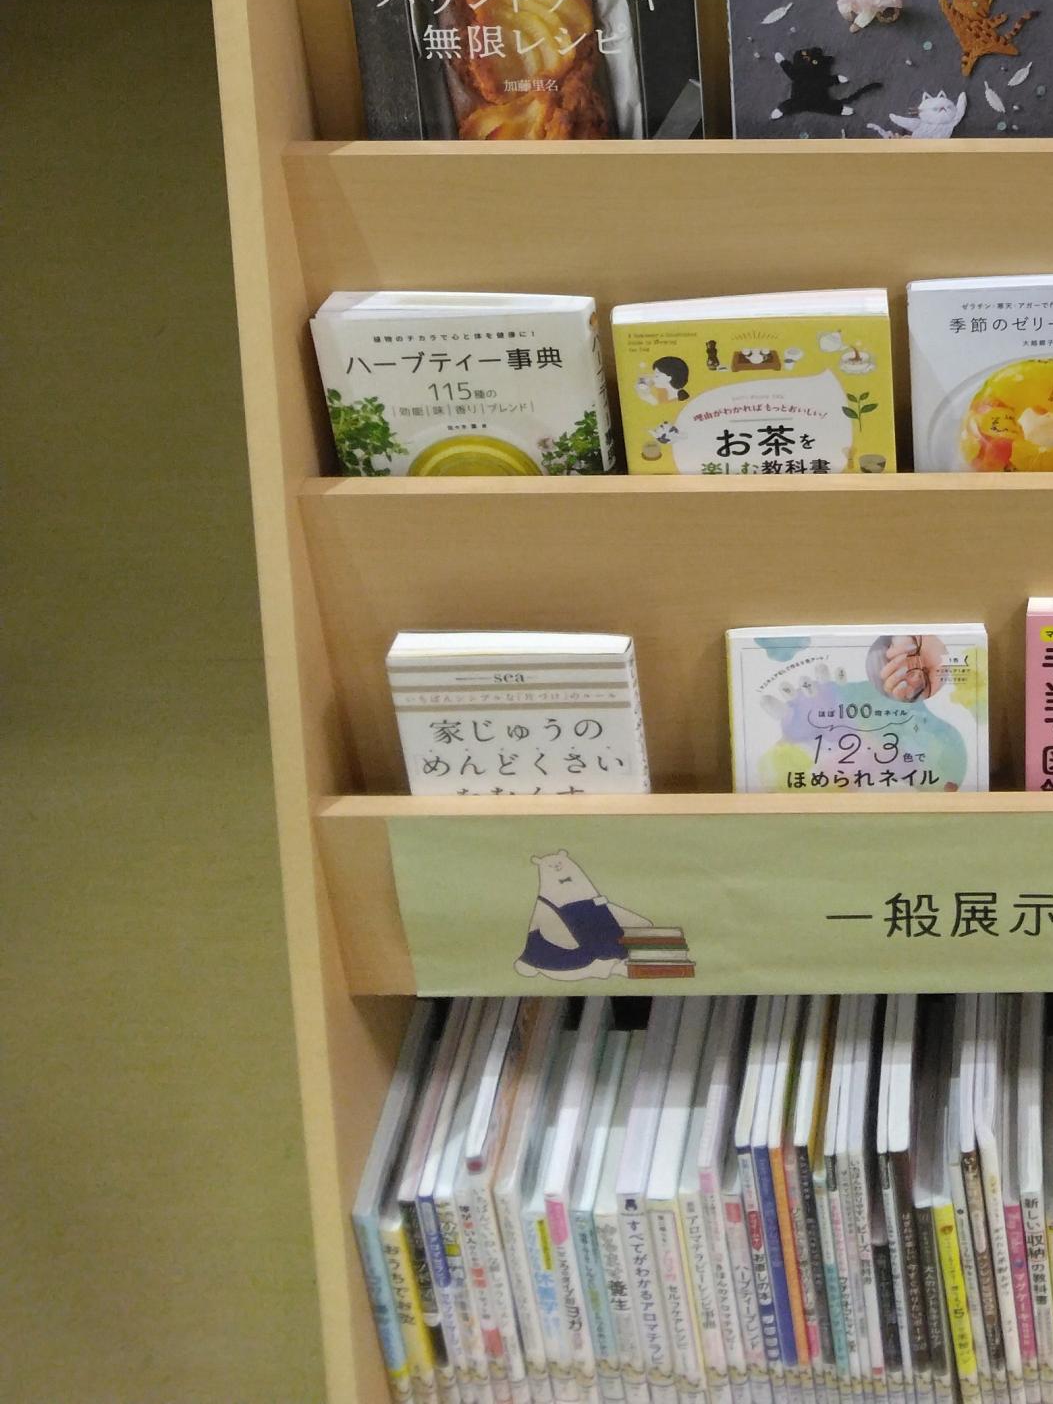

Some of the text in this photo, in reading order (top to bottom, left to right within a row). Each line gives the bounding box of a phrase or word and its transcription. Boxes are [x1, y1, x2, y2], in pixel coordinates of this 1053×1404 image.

[422, 24, 627, 60] 無限レシピ
[503, 79, 559, 93] 加藤里名
[346, 346, 563, 375] ハーブティー事典
[716, 424, 816, 457] お茶を
[701, 459, 831, 474] 楽しむ教科書
[493, 672, 525, 683] sea
[429, 719, 603, 744] 家じゅうの
[422, 753, 624, 777] めんどくさい
[787, 768, 940, 788] ほめられネイル
